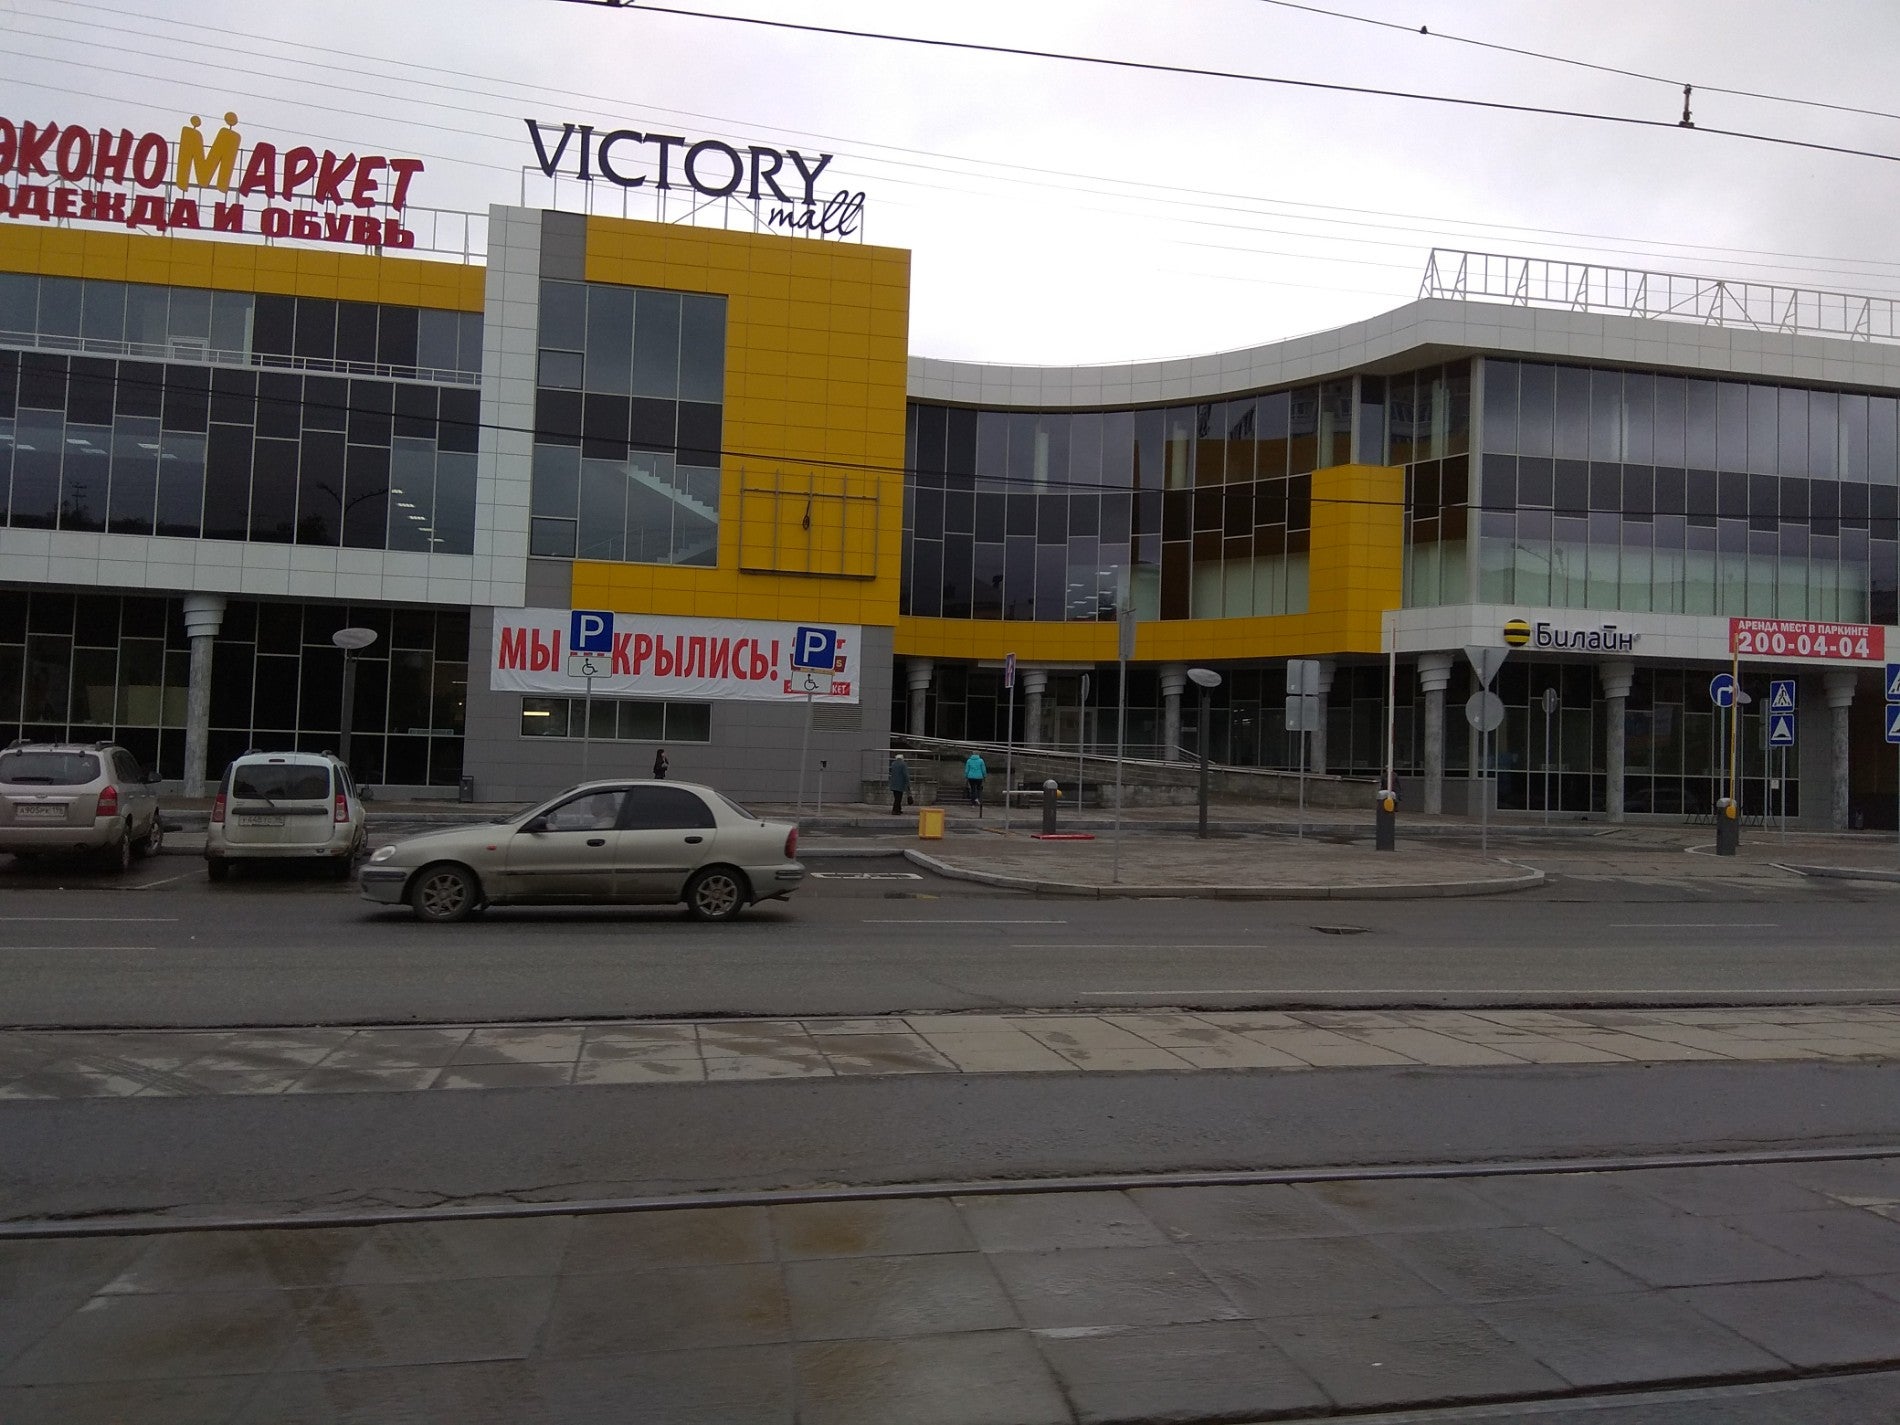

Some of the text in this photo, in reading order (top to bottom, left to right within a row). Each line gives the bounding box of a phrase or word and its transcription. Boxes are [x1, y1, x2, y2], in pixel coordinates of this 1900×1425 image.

[523, 118, 834, 206] VICTORY
[213, 202, 245, 233] И
[260, 207, 415, 249] ОБУВЬ
[767, 190, 866, 236] mall
[578, 614, 605, 648] P
[1536, 622, 1633, 651] Билайн
[1738, 620, 1869, 636] АРЕНДА МЕСТ В ПАРКИНГЕ
[1738, 631, 1870, 658] 200-04-04
[498, 627, 561, 672] МЫ
[802, 631, 827, 664] P
